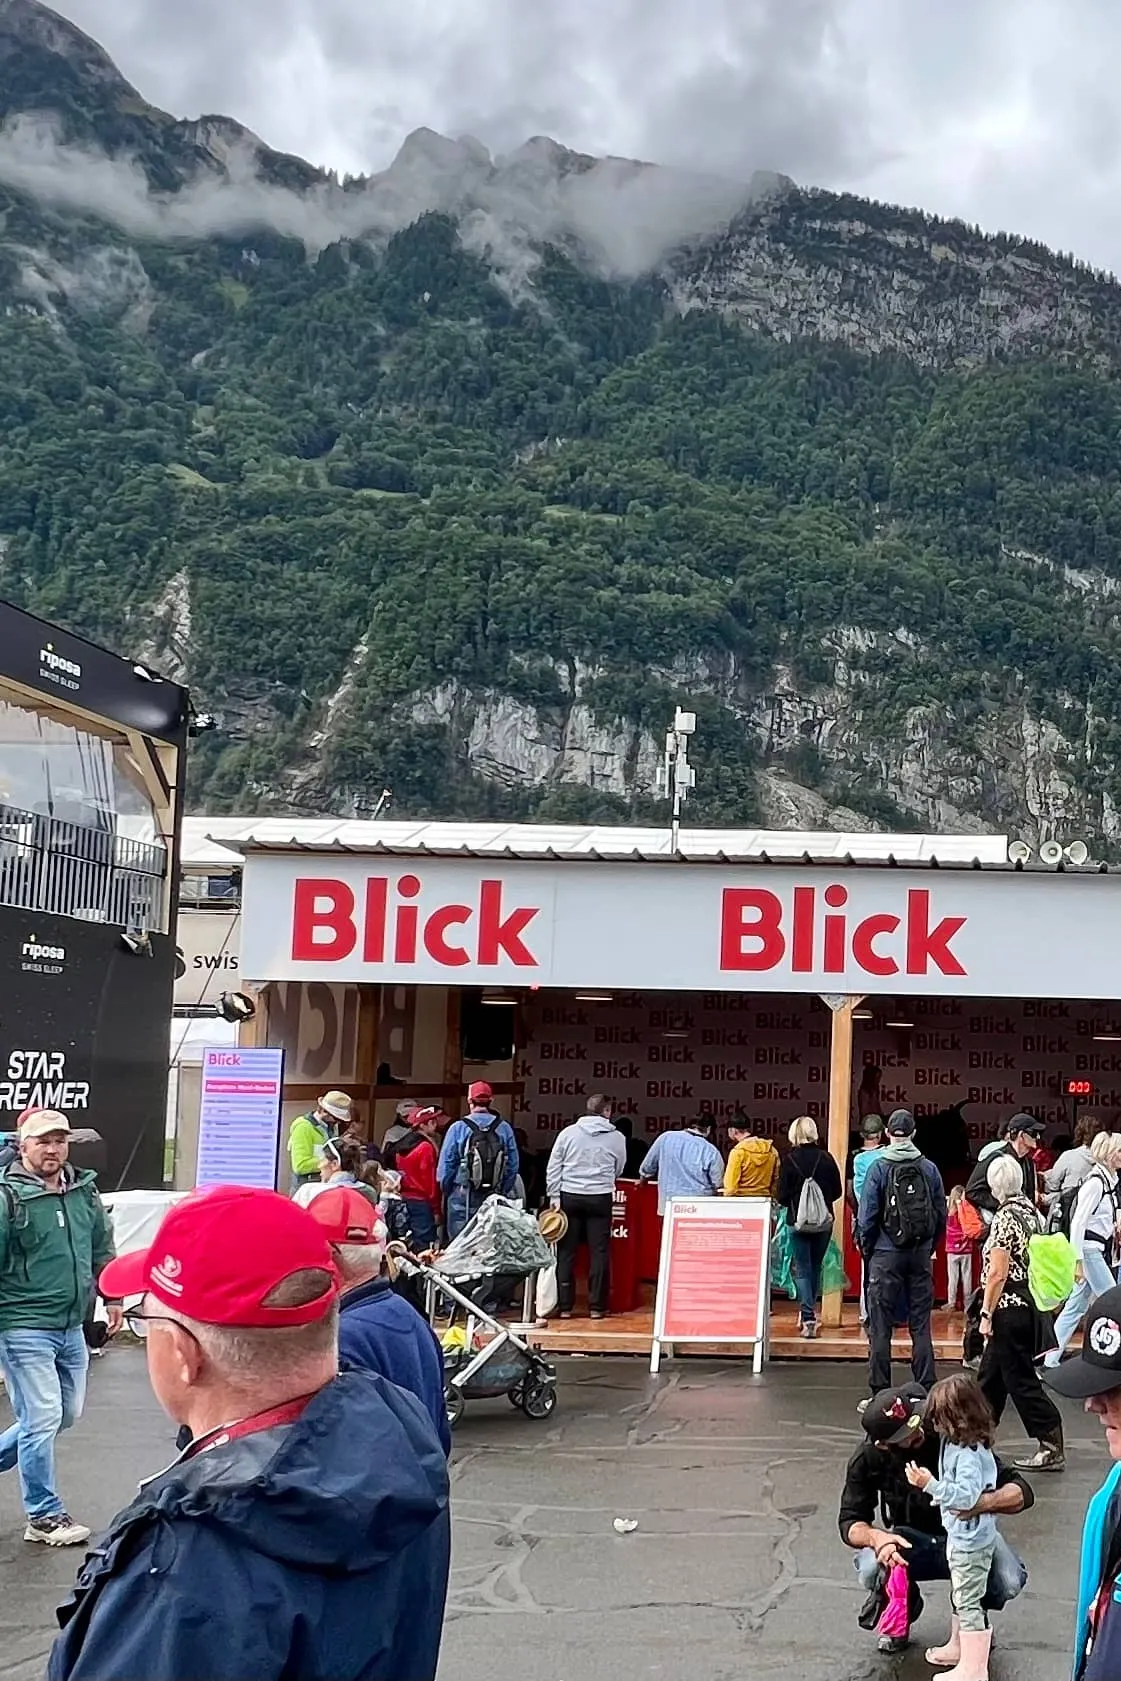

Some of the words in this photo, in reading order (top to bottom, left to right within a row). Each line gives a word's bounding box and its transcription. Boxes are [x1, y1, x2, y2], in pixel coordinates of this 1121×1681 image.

[40, 643, 81, 677] riposa
[291, 875, 541, 966] Blick
[720, 884, 968, 976] Blick
[22, 934, 65, 960] riposa
[542, 1008, 589, 1024] Blick
[916, 1000, 962, 1015] Blick
[1023, 1001, 1070, 1018] Blick
[755, 1013, 803, 1029] Blick
[969, 1017, 1016, 1034] Blick
[594, 1027, 642, 1043] Blick
[702, 1029, 749, 1046] Blick
[916, 1034, 962, 1049] Blick
[540, 1043, 587, 1059] Blick
[1023, 1036, 1069, 1053] Blick
[208, 1053, 241, 1066] Blick
[648, 1046, 695, 1063] Blick
[755, 1048, 801, 1064] Blick
[968, 1052, 1016, 1069] Blick
[7, 1050, 65, 1079] STAR
[593, 1062, 640, 1079] Blick
[701, 1064, 747, 1081] Blick
[914, 1069, 961, 1085] Blick
[538, 1078, 586, 1095] Blick
[646, 1081, 693, 1098] Blick
[754, 1083, 800, 1100] Blick
[881, 1085, 908, 1102] ick
[967, 1087, 1015, 1104] Blick
[753, 1118, 790, 1134] Blic
[673, 1204, 698, 1214] Blick
